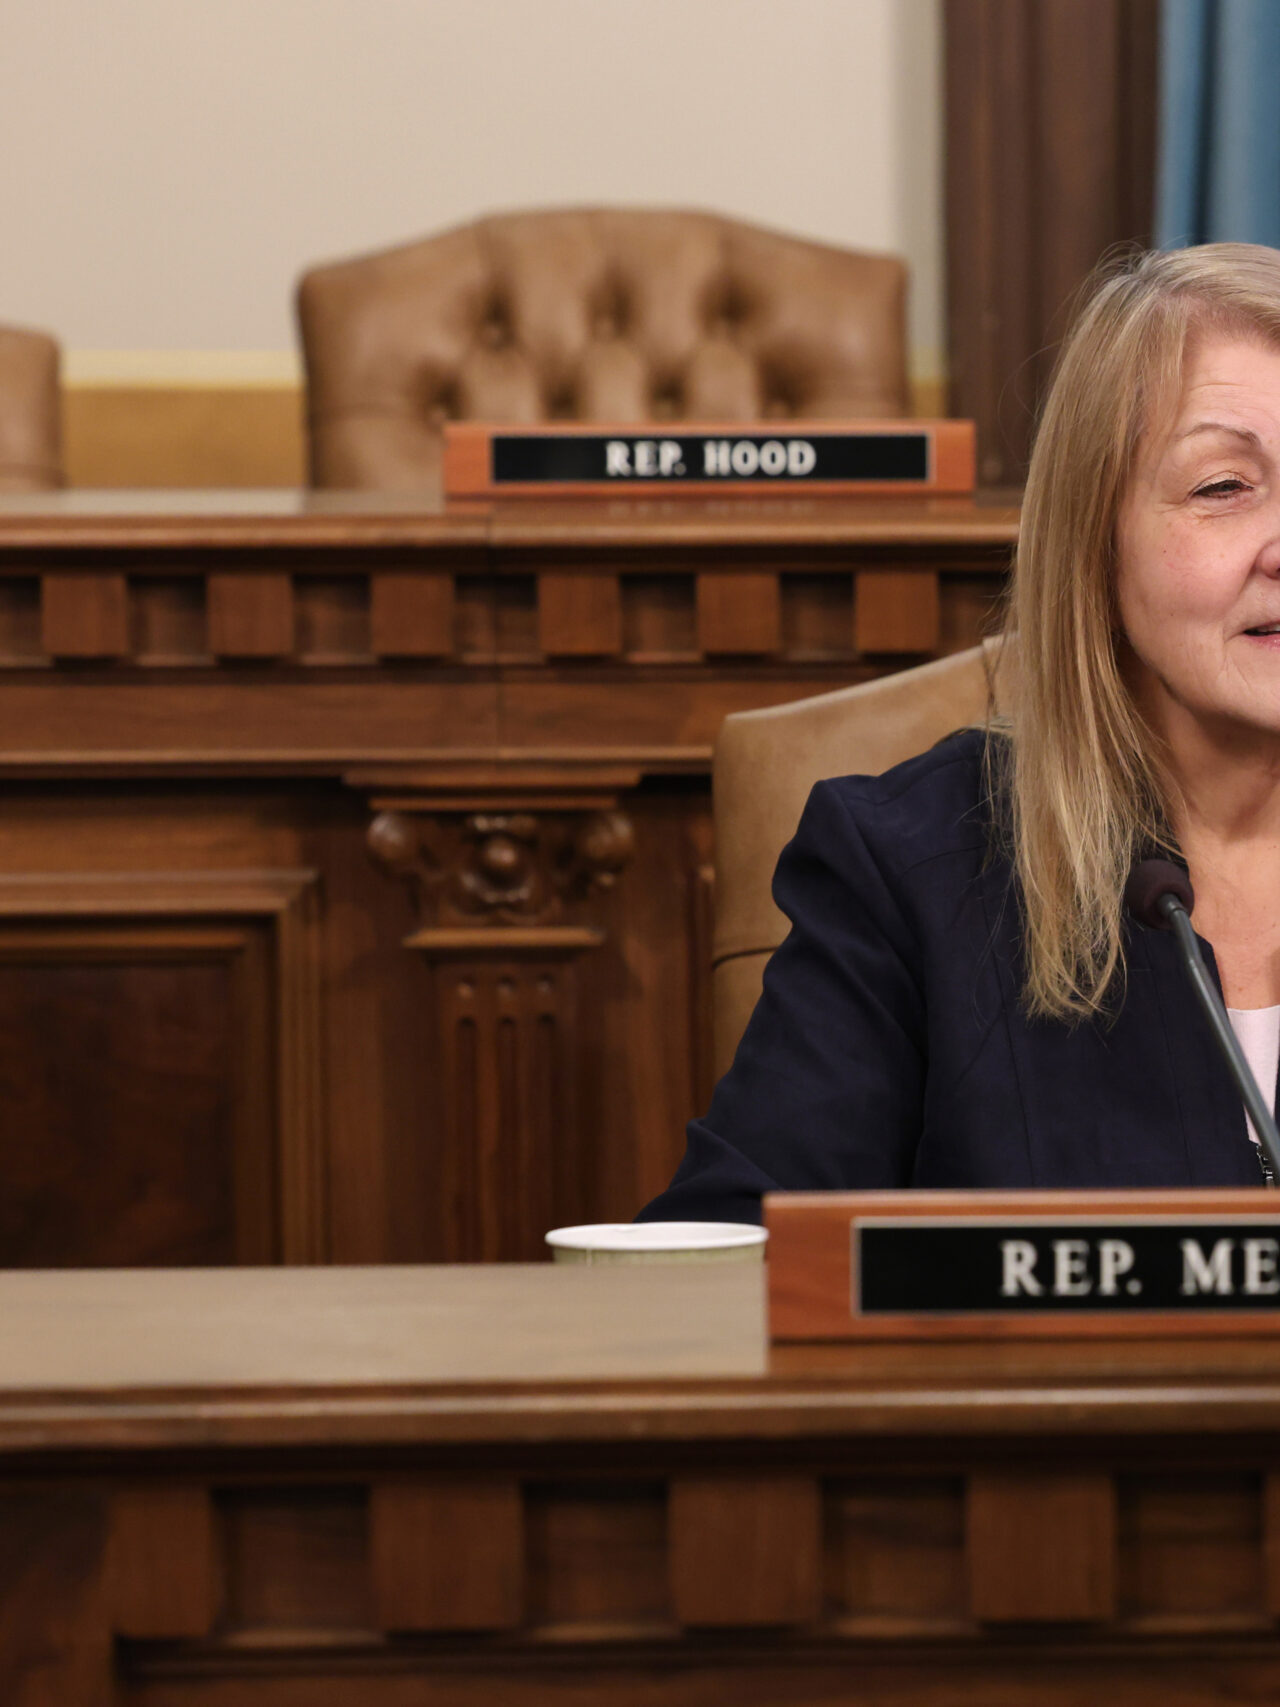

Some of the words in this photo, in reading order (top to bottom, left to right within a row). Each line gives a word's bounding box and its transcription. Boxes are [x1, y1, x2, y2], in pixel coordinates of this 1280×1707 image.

[605, 441, 687, 475] REP.
[703, 441, 817, 475] HOOD
[1001, 1240, 1142, 1297] REP.
